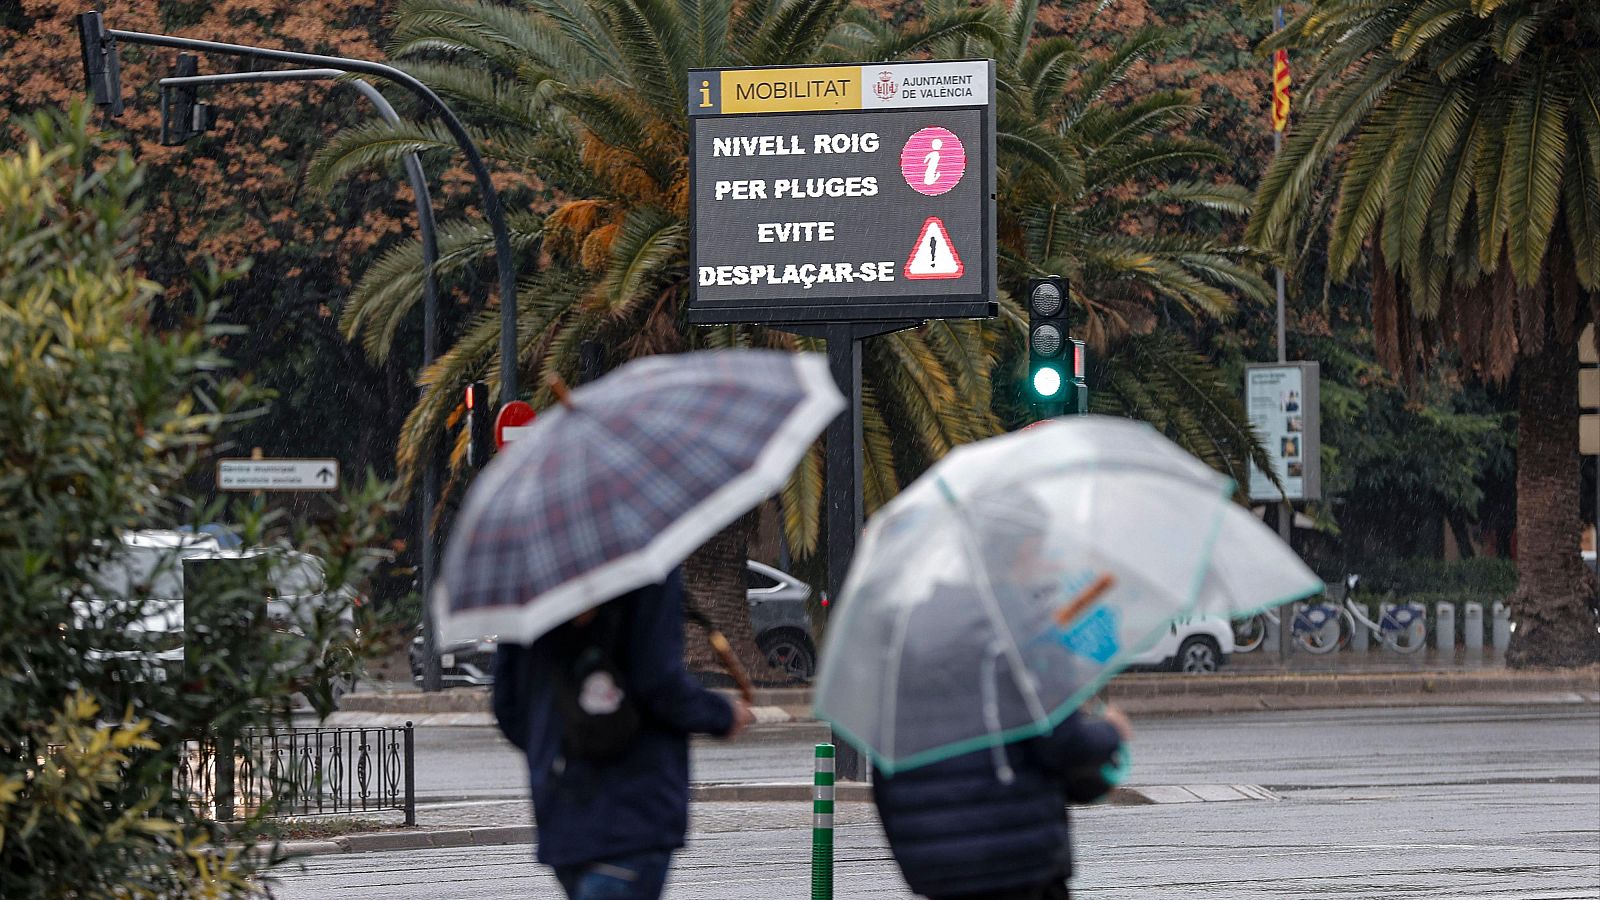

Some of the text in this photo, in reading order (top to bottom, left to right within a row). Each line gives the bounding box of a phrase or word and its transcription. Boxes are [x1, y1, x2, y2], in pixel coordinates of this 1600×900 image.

[736, 79, 851, 101] MOBILITAT
[902, 75, 973, 87] AJUNTAMENT
[902, 86, 973, 99] DE VALÈNCIA
[713, 132, 880, 157] NIVELL ROIG
[715, 176, 879, 201] PER PLUGES
[757, 221, 835, 243] EVITE
[698, 261, 895, 289] DESPLAÇAR-SE
